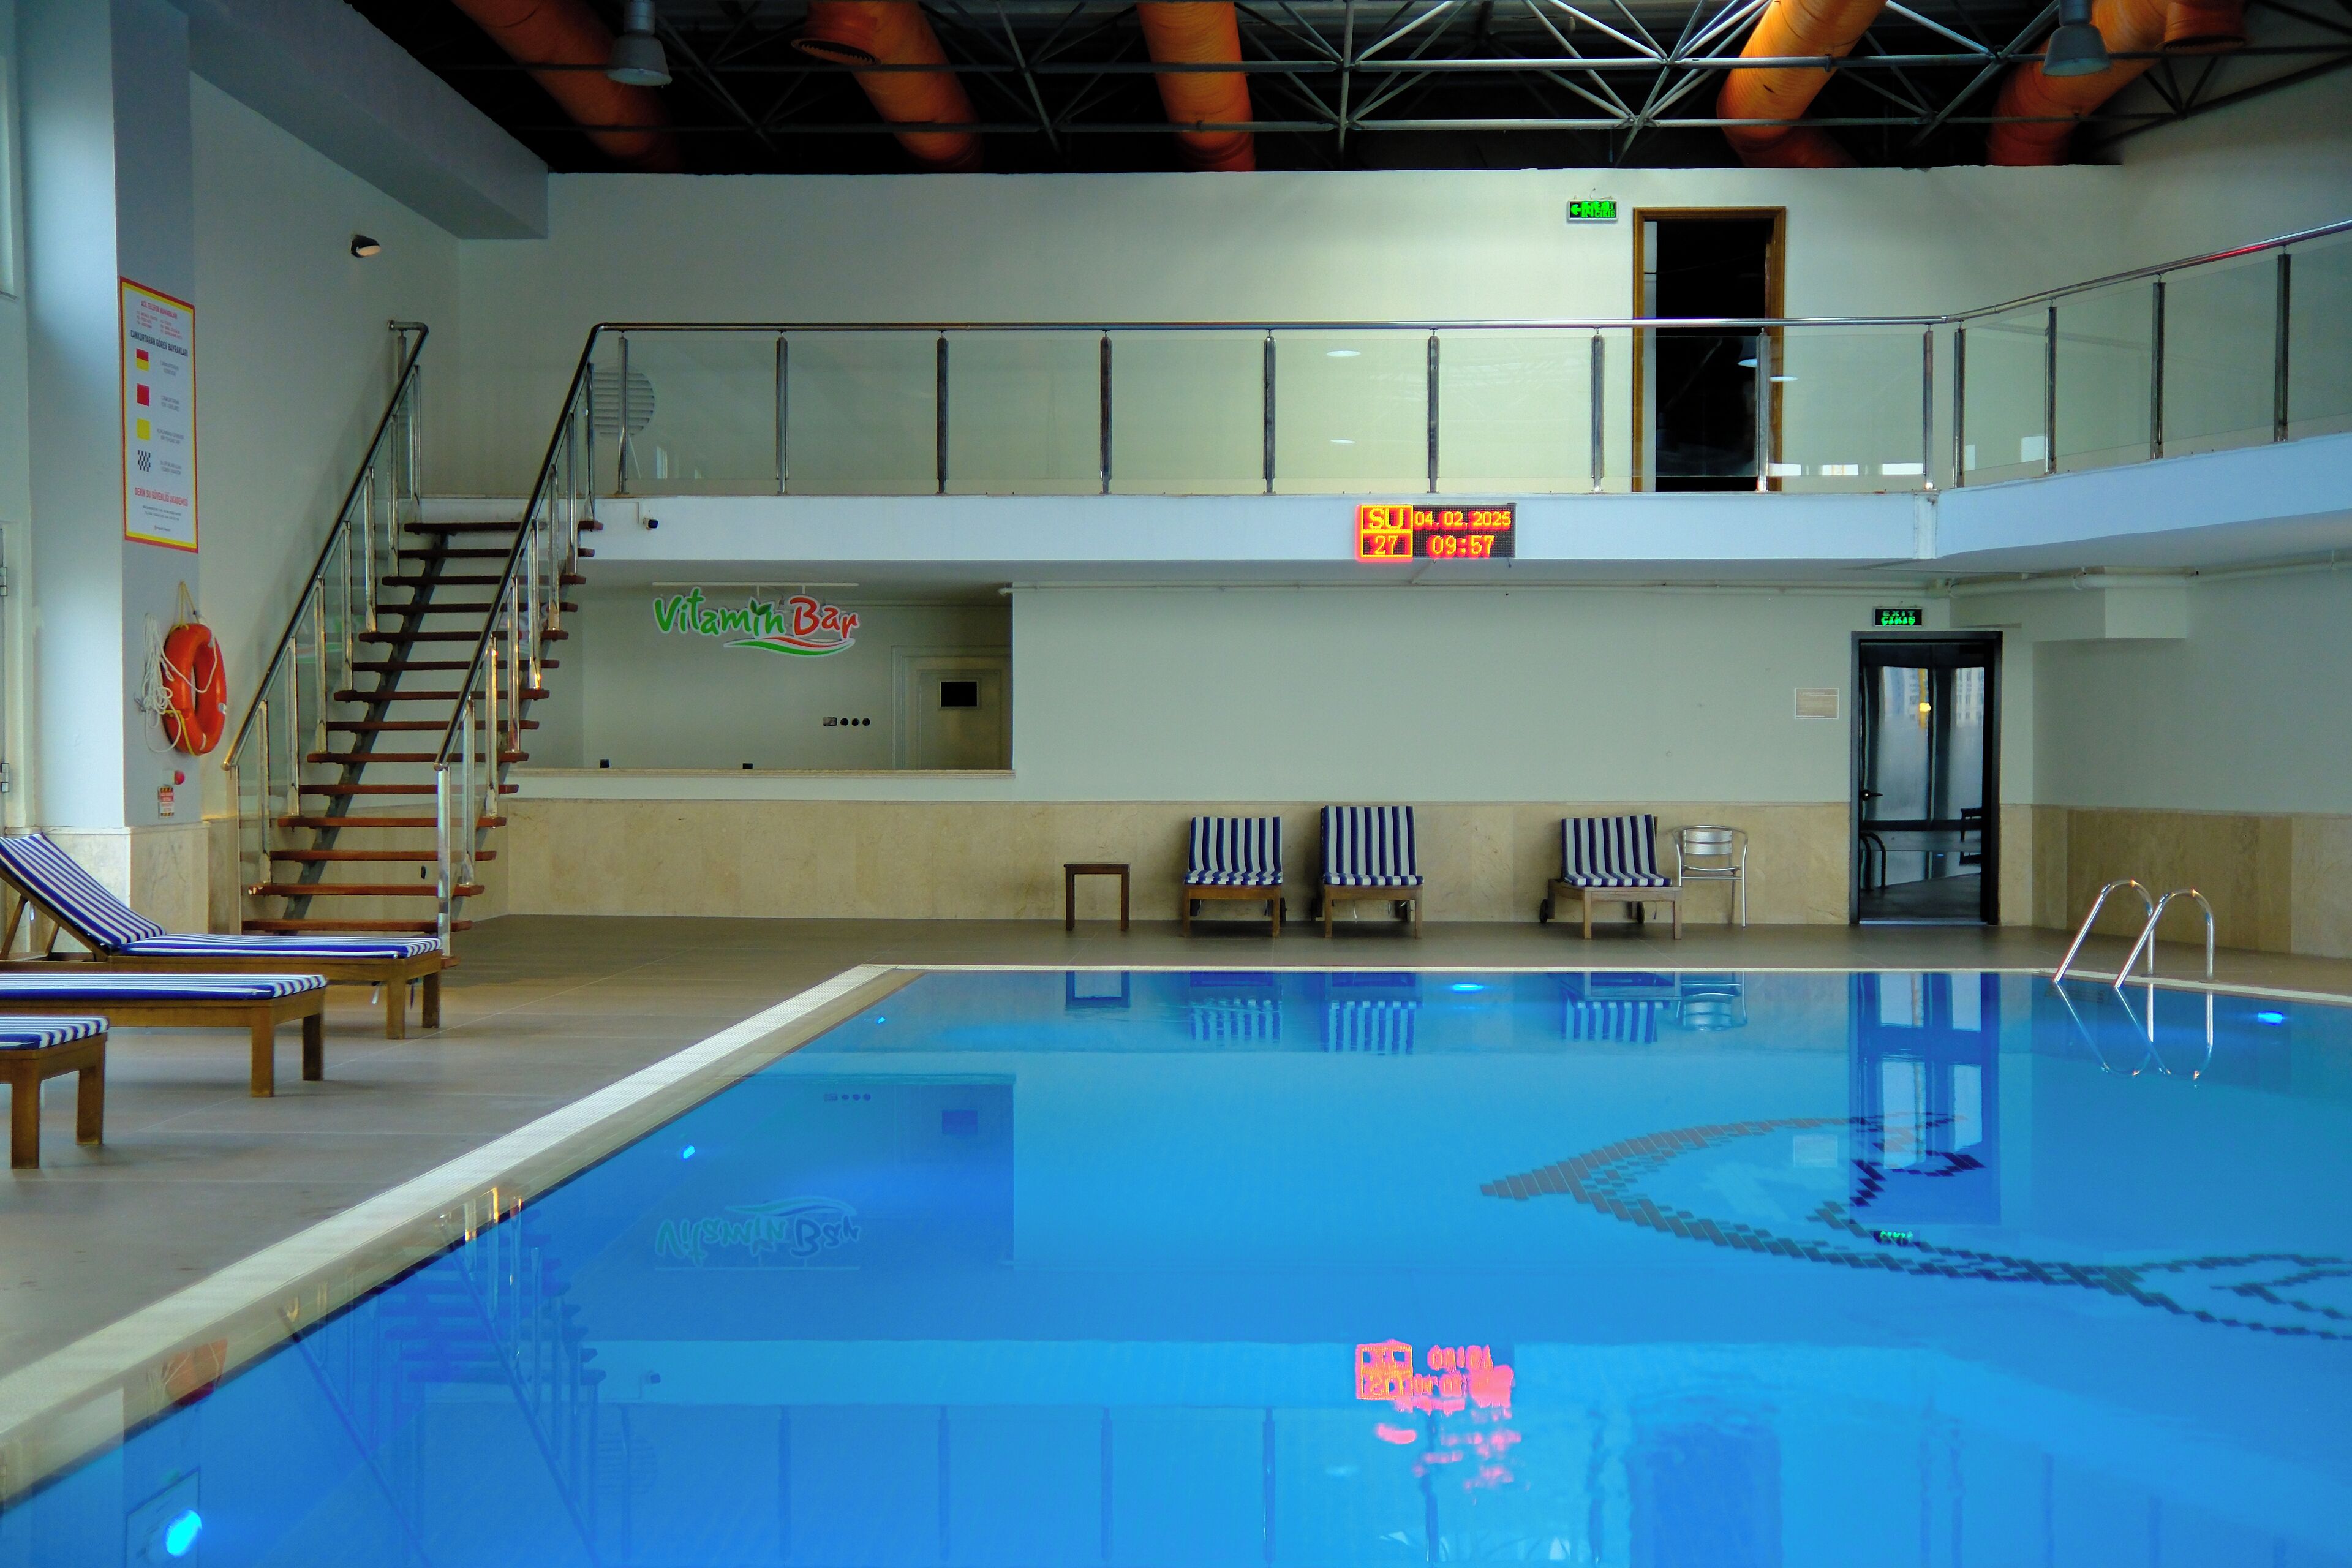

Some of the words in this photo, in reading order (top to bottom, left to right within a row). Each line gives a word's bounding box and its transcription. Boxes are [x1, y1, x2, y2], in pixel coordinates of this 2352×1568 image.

[1369, 508, 1404, 529] SU
[1374, 534, 1399, 555] 27
[1432, 535, 1495, 555] 09:57
[654, 586, 785, 636] Vitamin
[789, 595, 859, 639] Bar
